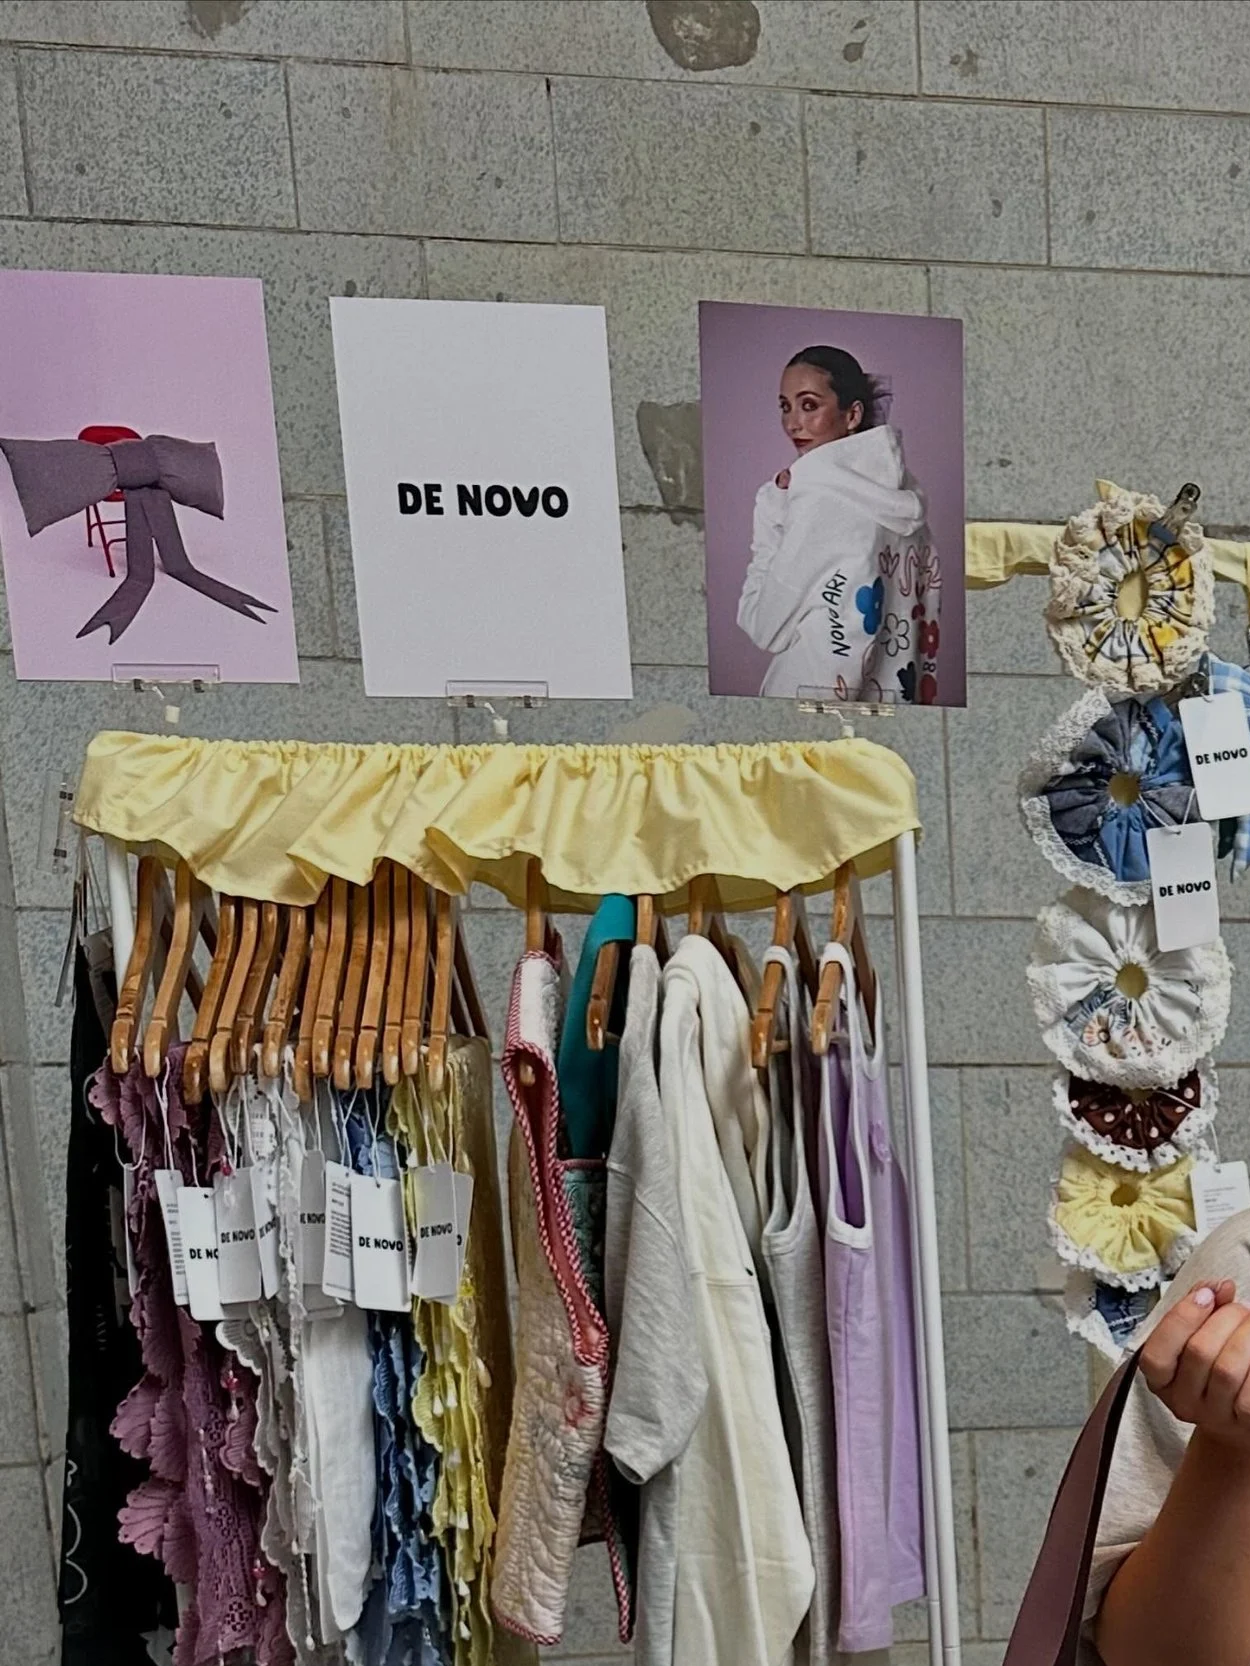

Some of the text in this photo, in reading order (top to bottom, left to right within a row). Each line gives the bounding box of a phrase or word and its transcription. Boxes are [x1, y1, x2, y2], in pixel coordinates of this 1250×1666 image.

[398, 483, 569, 518] DE NOVO
[822, 569, 848, 606] ART
[1195, 748, 1248, 765] DE NOVO
[1159, 880, 1211, 897] DE NOVO
[220, 1228, 255, 1243] DE NOVO
[420, 1223, 453, 1238] DE NOVO
[359, 1236, 404, 1251] DE NOVO
[189, 1248, 203, 1259] DE
